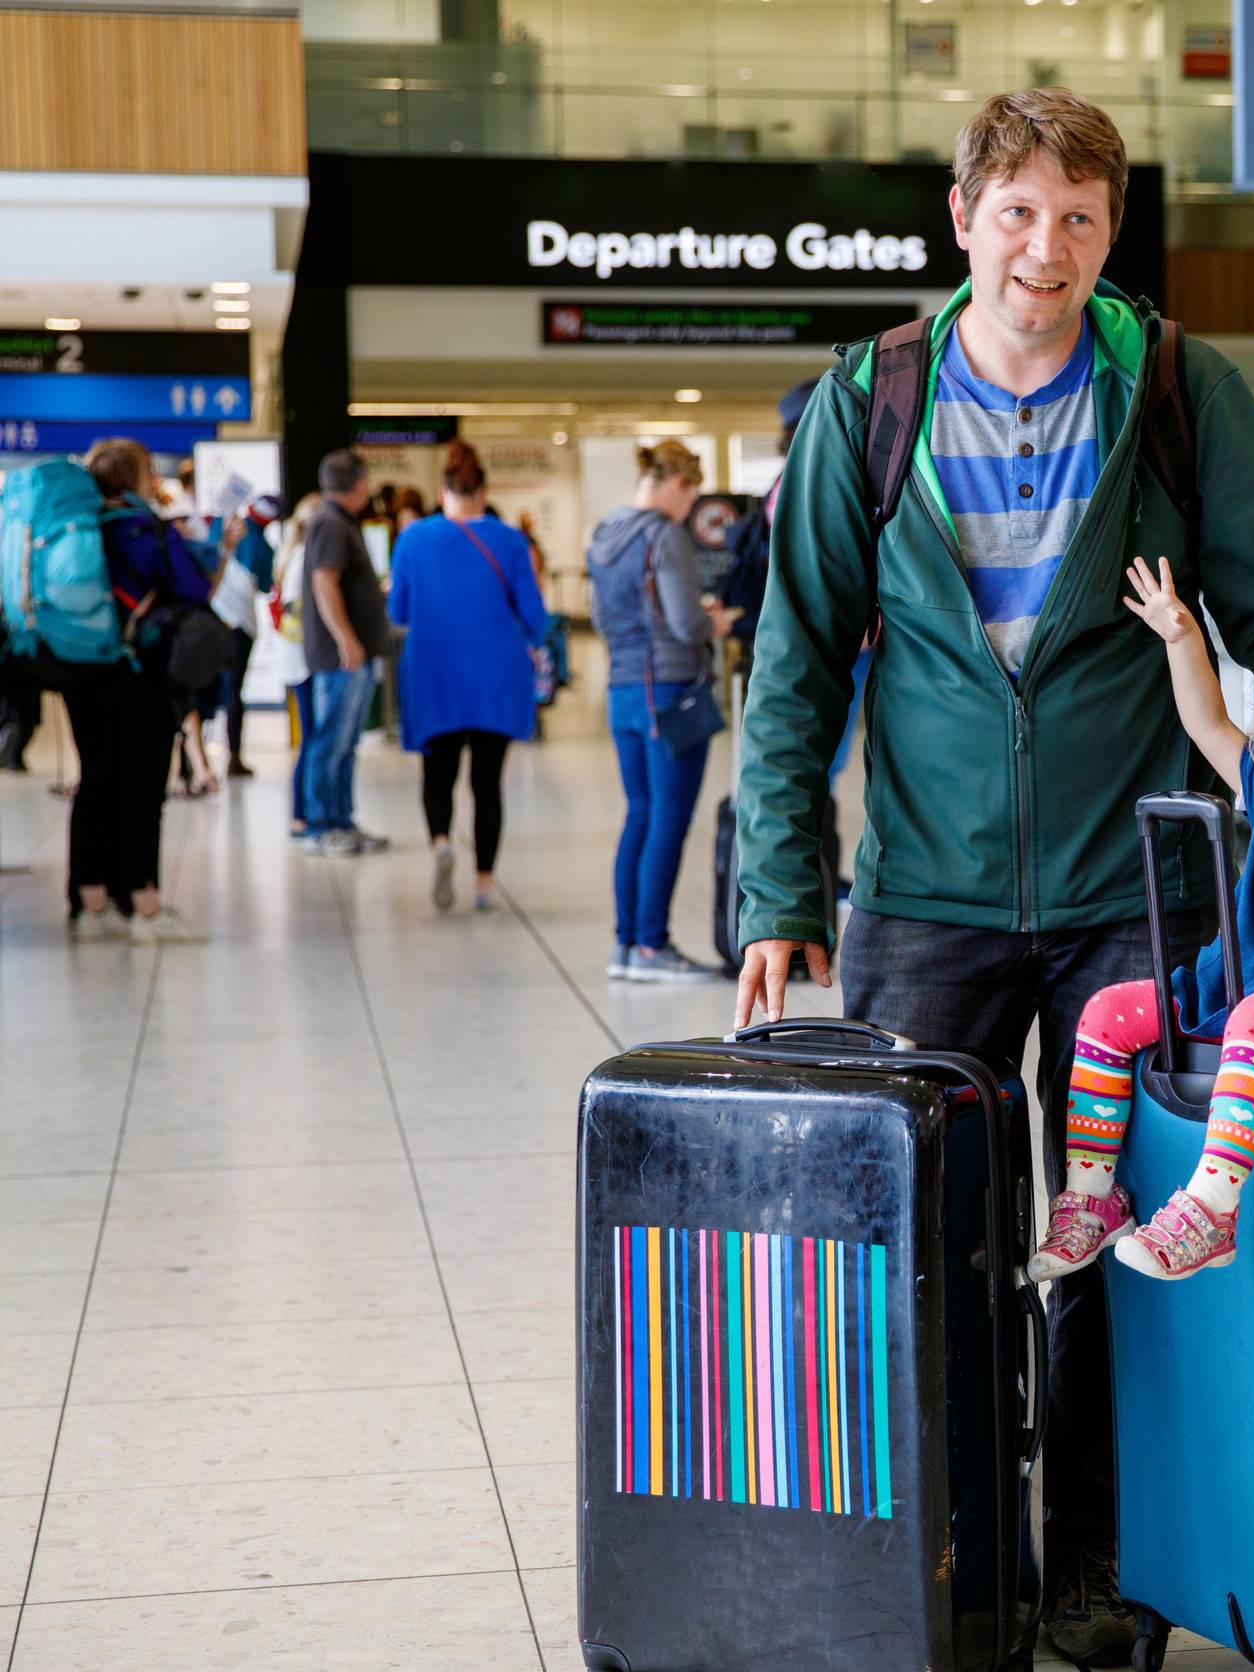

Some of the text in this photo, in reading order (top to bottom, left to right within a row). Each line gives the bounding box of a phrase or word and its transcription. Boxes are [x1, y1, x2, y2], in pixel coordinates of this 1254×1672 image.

[527, 219, 928, 279] Departure Gates
[55, 334, 84, 374] 2
